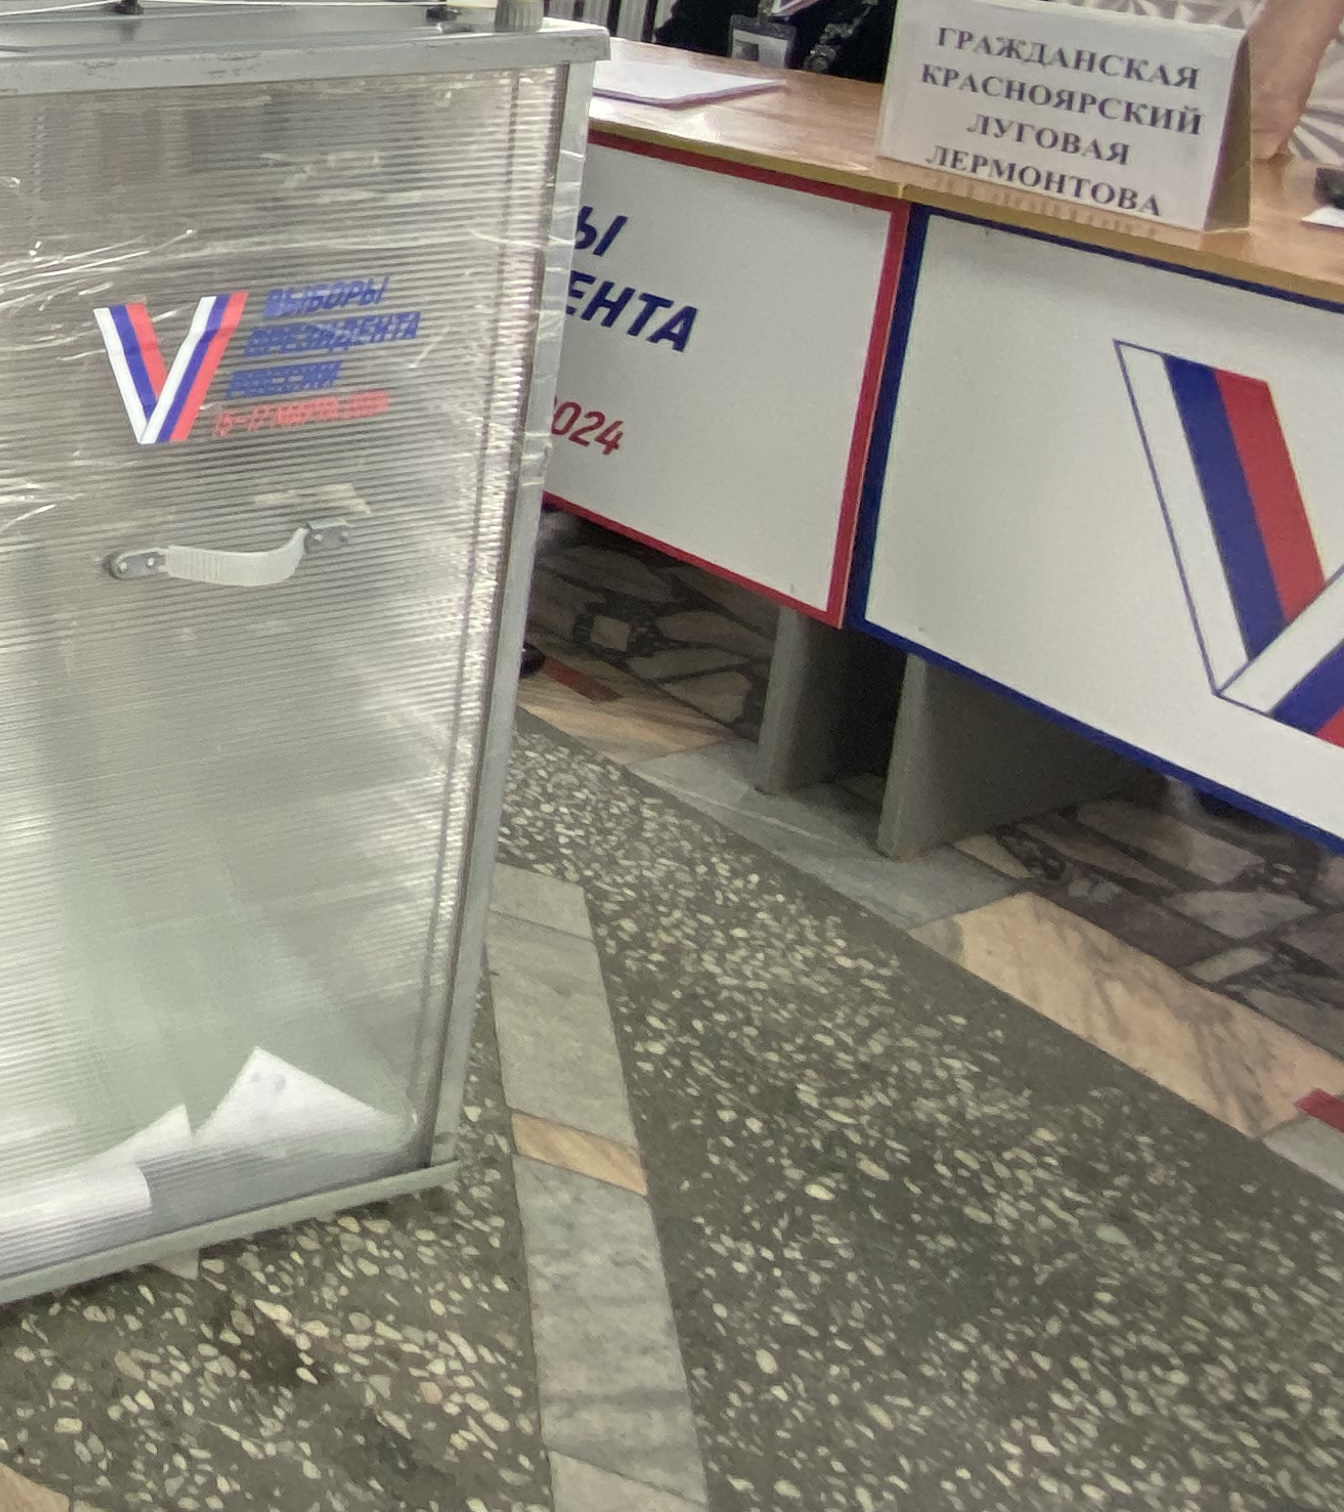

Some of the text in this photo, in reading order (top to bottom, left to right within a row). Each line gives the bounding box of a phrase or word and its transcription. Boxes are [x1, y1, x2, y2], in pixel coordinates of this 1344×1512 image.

[937, 27, 1200, 90] ГРАЖДАНСКАЯ
[921, 64, 1202, 135] КРАСНОЯРСКИЙ
[967, 114, 1130, 165] ЛУГОВАЯ
[926, 144, 1162, 217] ЛЕРМОНТОВА
[574, 206, 628, 257] Ы
[566, 270, 698, 352] ЕНТА
[551, 394, 624, 456] 024
